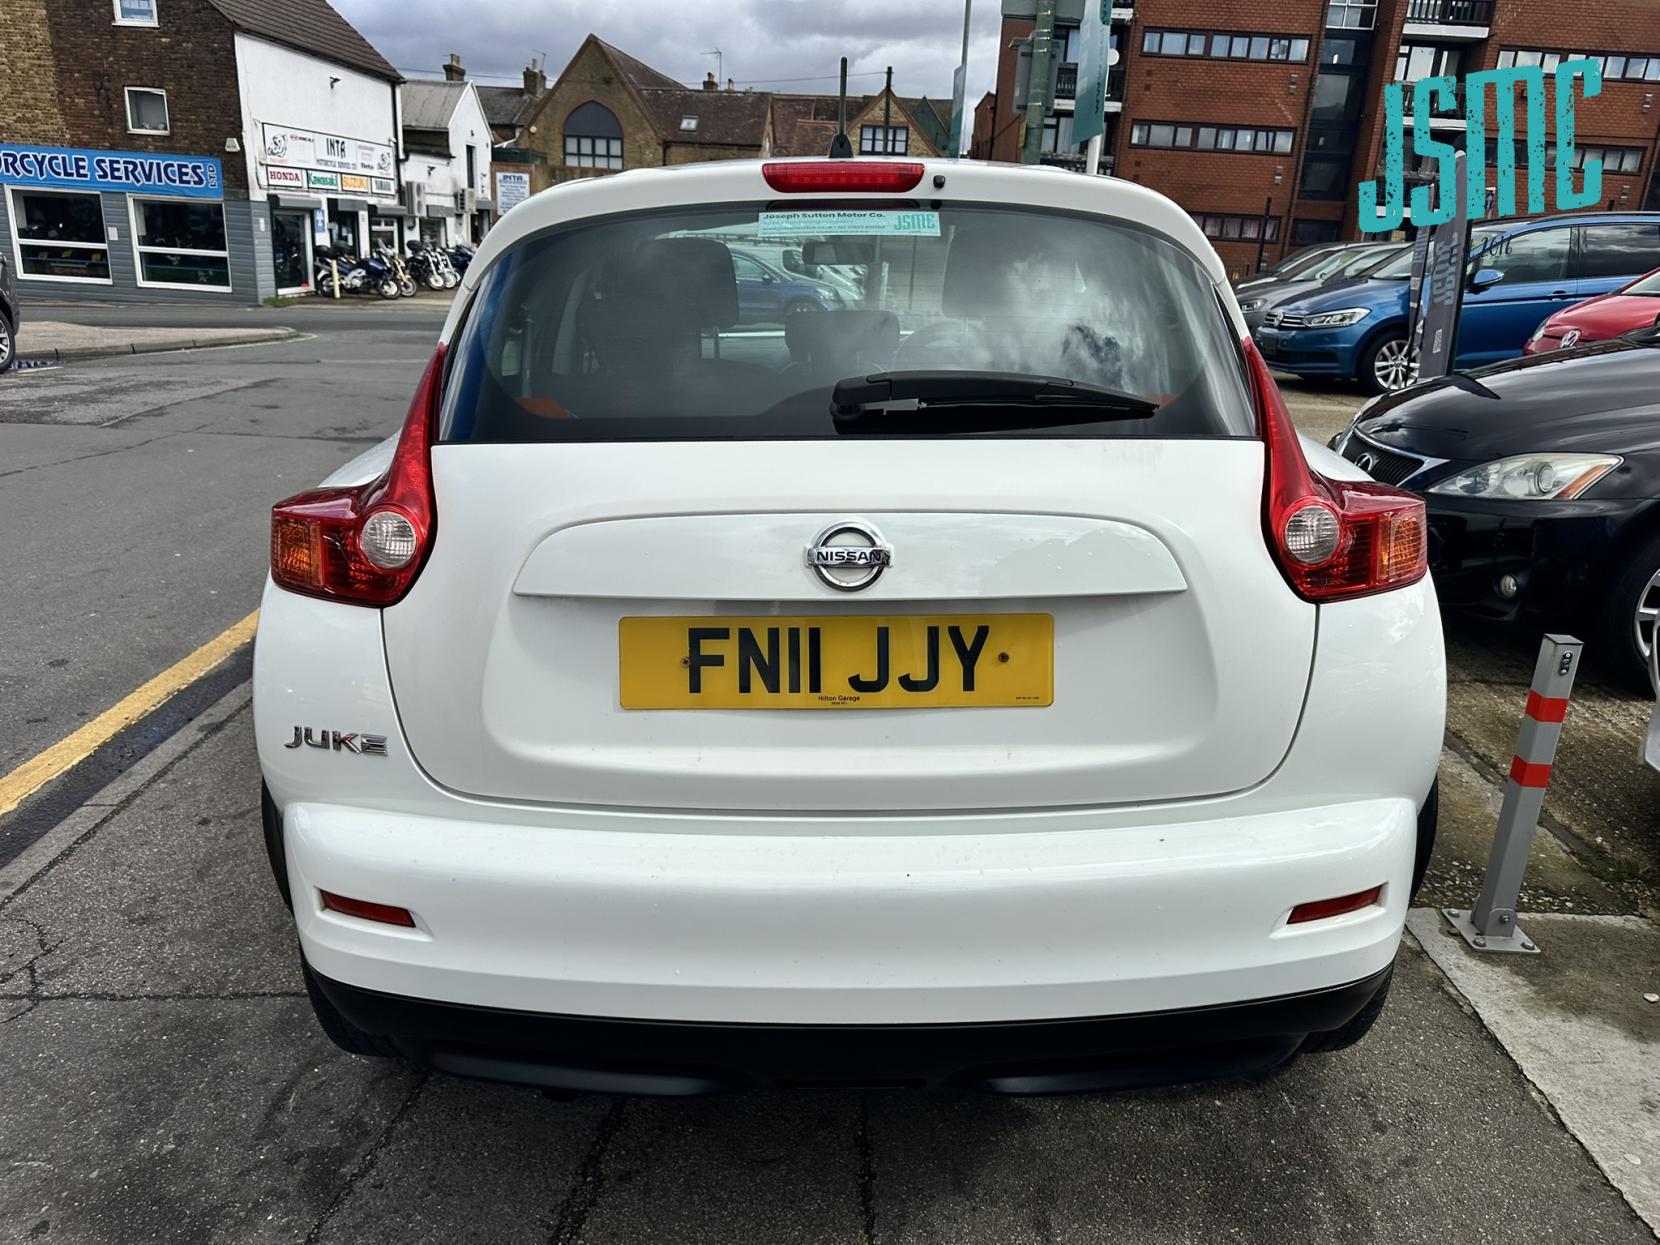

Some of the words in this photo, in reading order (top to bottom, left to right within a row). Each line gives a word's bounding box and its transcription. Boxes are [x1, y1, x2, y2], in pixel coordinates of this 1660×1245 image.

[326, 138, 346, 158] INTA
[0, 152, 89, 179] RCYCLE
[95, 157, 205, 187] SERVICES
[208, 164, 217, 188] LTD
[269, 171, 301, 182] HONDA
[308, 172, 338, 186] Kawasaki
[894, 213, 935, 230] JSMC
[816, 551, 881, 562] NISSAN
[688, 627, 822, 694] FN11
[847, 625, 990, 692] JJY
[838, 695, 861, 703] Garage
[284, 726, 389, 757] JUKE
